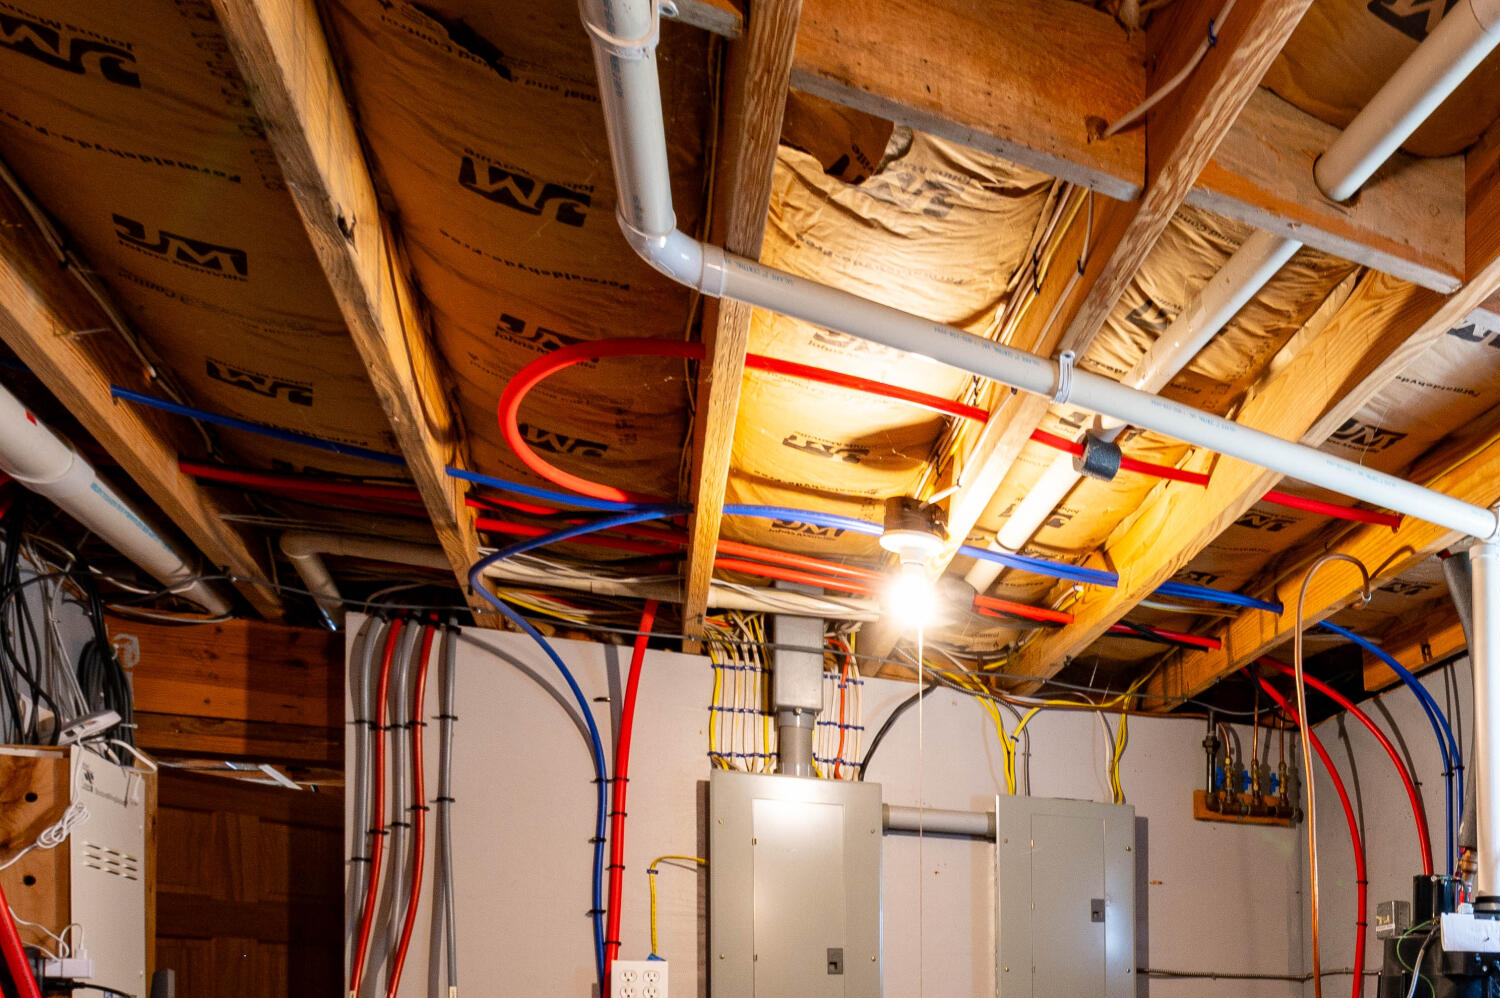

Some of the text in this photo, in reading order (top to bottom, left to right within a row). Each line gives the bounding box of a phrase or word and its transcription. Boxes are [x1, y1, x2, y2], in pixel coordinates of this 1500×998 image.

[0, 12, 142, 88] JM
[461, 156, 592, 227] JM
[112, 213, 249, 277] JM
[207, 360, 313, 407] JM
[1327, 417, 1407, 449] JM
